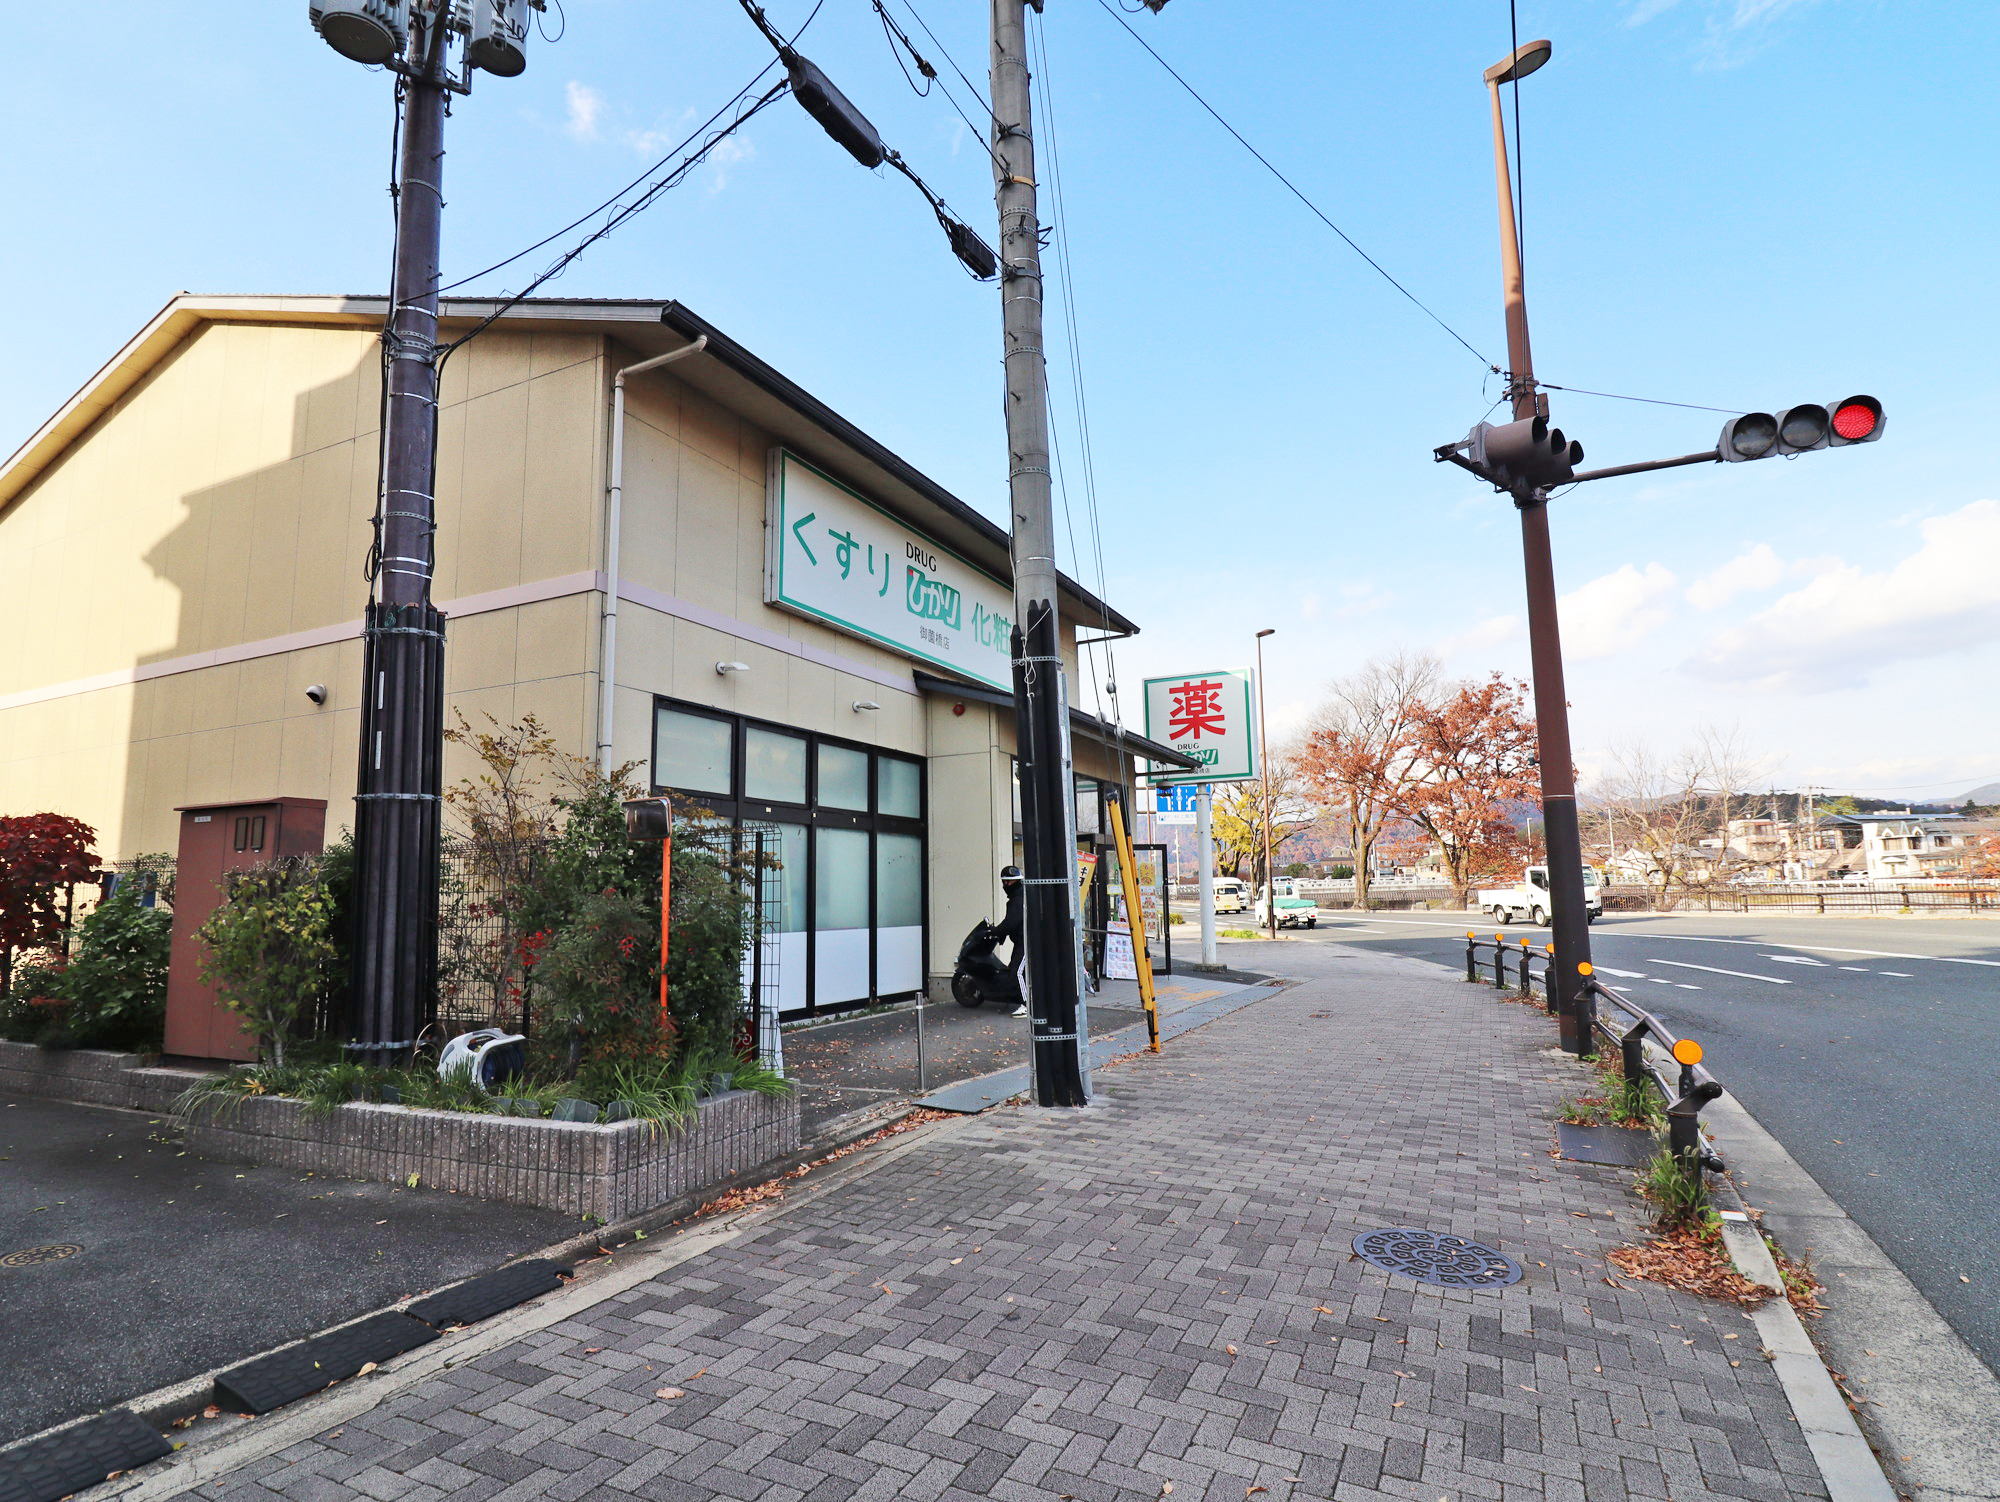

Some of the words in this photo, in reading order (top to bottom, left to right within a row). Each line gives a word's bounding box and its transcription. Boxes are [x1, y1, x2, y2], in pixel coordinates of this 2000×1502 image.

[792, 512, 889, 597] くすり
[906, 541, 937, 572] DRUG
[908, 567, 960, 628] ひかり
[1169, 679, 1227, 741] 薬
